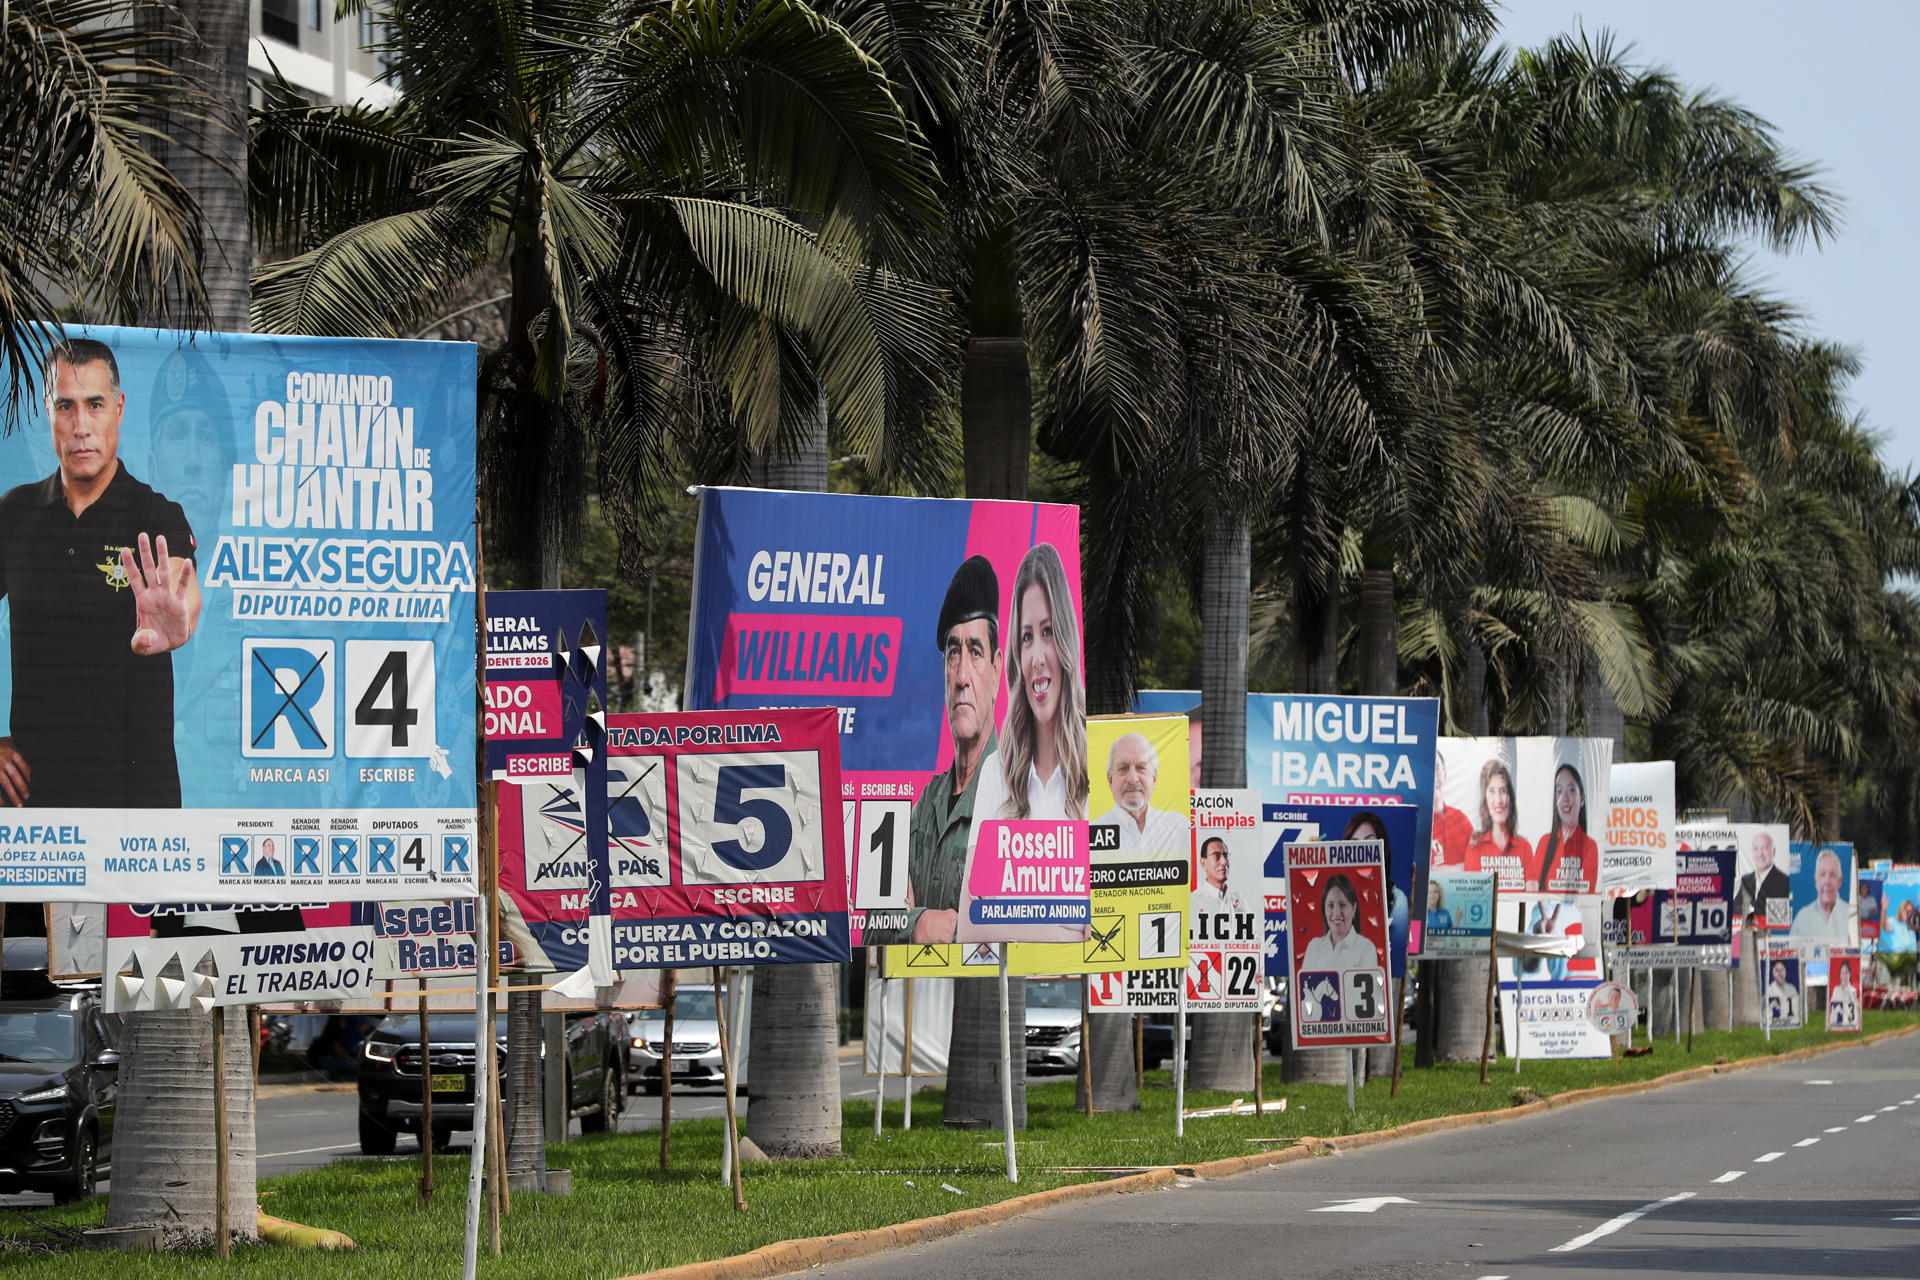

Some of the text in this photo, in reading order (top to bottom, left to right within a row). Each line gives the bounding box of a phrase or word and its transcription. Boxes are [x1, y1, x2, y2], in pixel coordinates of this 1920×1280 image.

[287, 371, 392, 407] COMANDO
[414, 449, 431, 468] DE
[208, 540, 474, 588] ALEX SEGURA
[748, 550, 885, 605] GENERAL
[237, 594, 446, 618] DIPUTADO POR LIMA
[486, 616, 540, 632] NERAL
[486, 635, 548, 651] LLIAMS
[525, 656, 549, 666] 2026
[736, 629, 890, 683] WILLIAMS
[251, 647, 327, 749] R
[355, 651, 418, 747] 4
[1273, 701, 1418, 744] MIGUEL
[675, 724, 782, 745] POR LIMA
[509, 757, 571, 773] ESCRIBE
[1272, 751, 1417, 790] IBARRA
[250, 768, 330, 782] MARCA ASI
[359, 769, 415, 782] ESCRIBE
[861, 781, 914, 796] ESCRIBE ASÍ:
[372, 821, 418, 829] DIPUTADOS
[711, 764, 792, 871] 5
[1200, 811, 1255, 828] Limpias
[1273, 812, 1308, 821] ESCRIBE
[0, 825, 86, 844] RAFAEL
[997, 826, 1074, 860] Rosselli
[1606, 830, 1666, 848] UESTOS
[120, 837, 190, 854] VOTA ASI,
[222, 837, 249, 873] R
[369, 837, 396, 872] R
[403, 838, 426, 872] 4
[444, 837, 469, 872] R
[870, 812, 895, 896] 1
[1288, 845, 1381, 865] MARIA PARIONA
[40, 851, 86, 861] ALIAGA
[104, 858, 205, 872] MARCA LAS 5
[293, 838, 320, 873] R
[331, 838, 358, 873] R
[0, 868, 85, 882] PRESIDENTE
[537, 856, 660, 878] AVAN PAÍS
[1001, 860, 1086, 893] Amuruz
[1119, 867, 1179, 882] CATERIANO
[1678, 877, 1711, 885] SENADO
[560, 893, 638, 910] MACA
[714, 887, 794, 904] ESCRIBE
[1094, 888, 1165, 898] SENADOR NACIONAL
[981, 905, 1086, 919] PARLAMENTO ANDINO
[1094, 906, 1115, 914] MARCA
[1148, 903, 1171, 911] ESCRIBE
[1470, 904, 1483, 922] 9
[869, 915, 908, 930] ANDINO
[1190, 913, 1254, 940] ICH
[1701, 909, 1724, 928] 10
[561, 919, 827, 945] CO FUERZA Y CORAZON
[1151, 917, 1165, 953] 1
[240, 942, 345, 966] TURISMO
[398, 938, 516, 971] Rabaa
[615, 941, 777, 964] POR EL PUEBLO.
[226, 975, 247, 995] EL
[257, 968, 360, 993] TRABAJO
[1228, 956, 1256, 995] 22
[1353, 974, 1375, 1019] 3
[1556, 993, 1575, 1004] las
[1579, 993, 1586, 1003] 5
[1787, 998, 1794, 1016] 1
[1848, 1002, 1855, 1020] 3
[1302, 1021, 1386, 1035] SENADORA NACIONAL
[1617, 1015, 1625, 1028] 9
